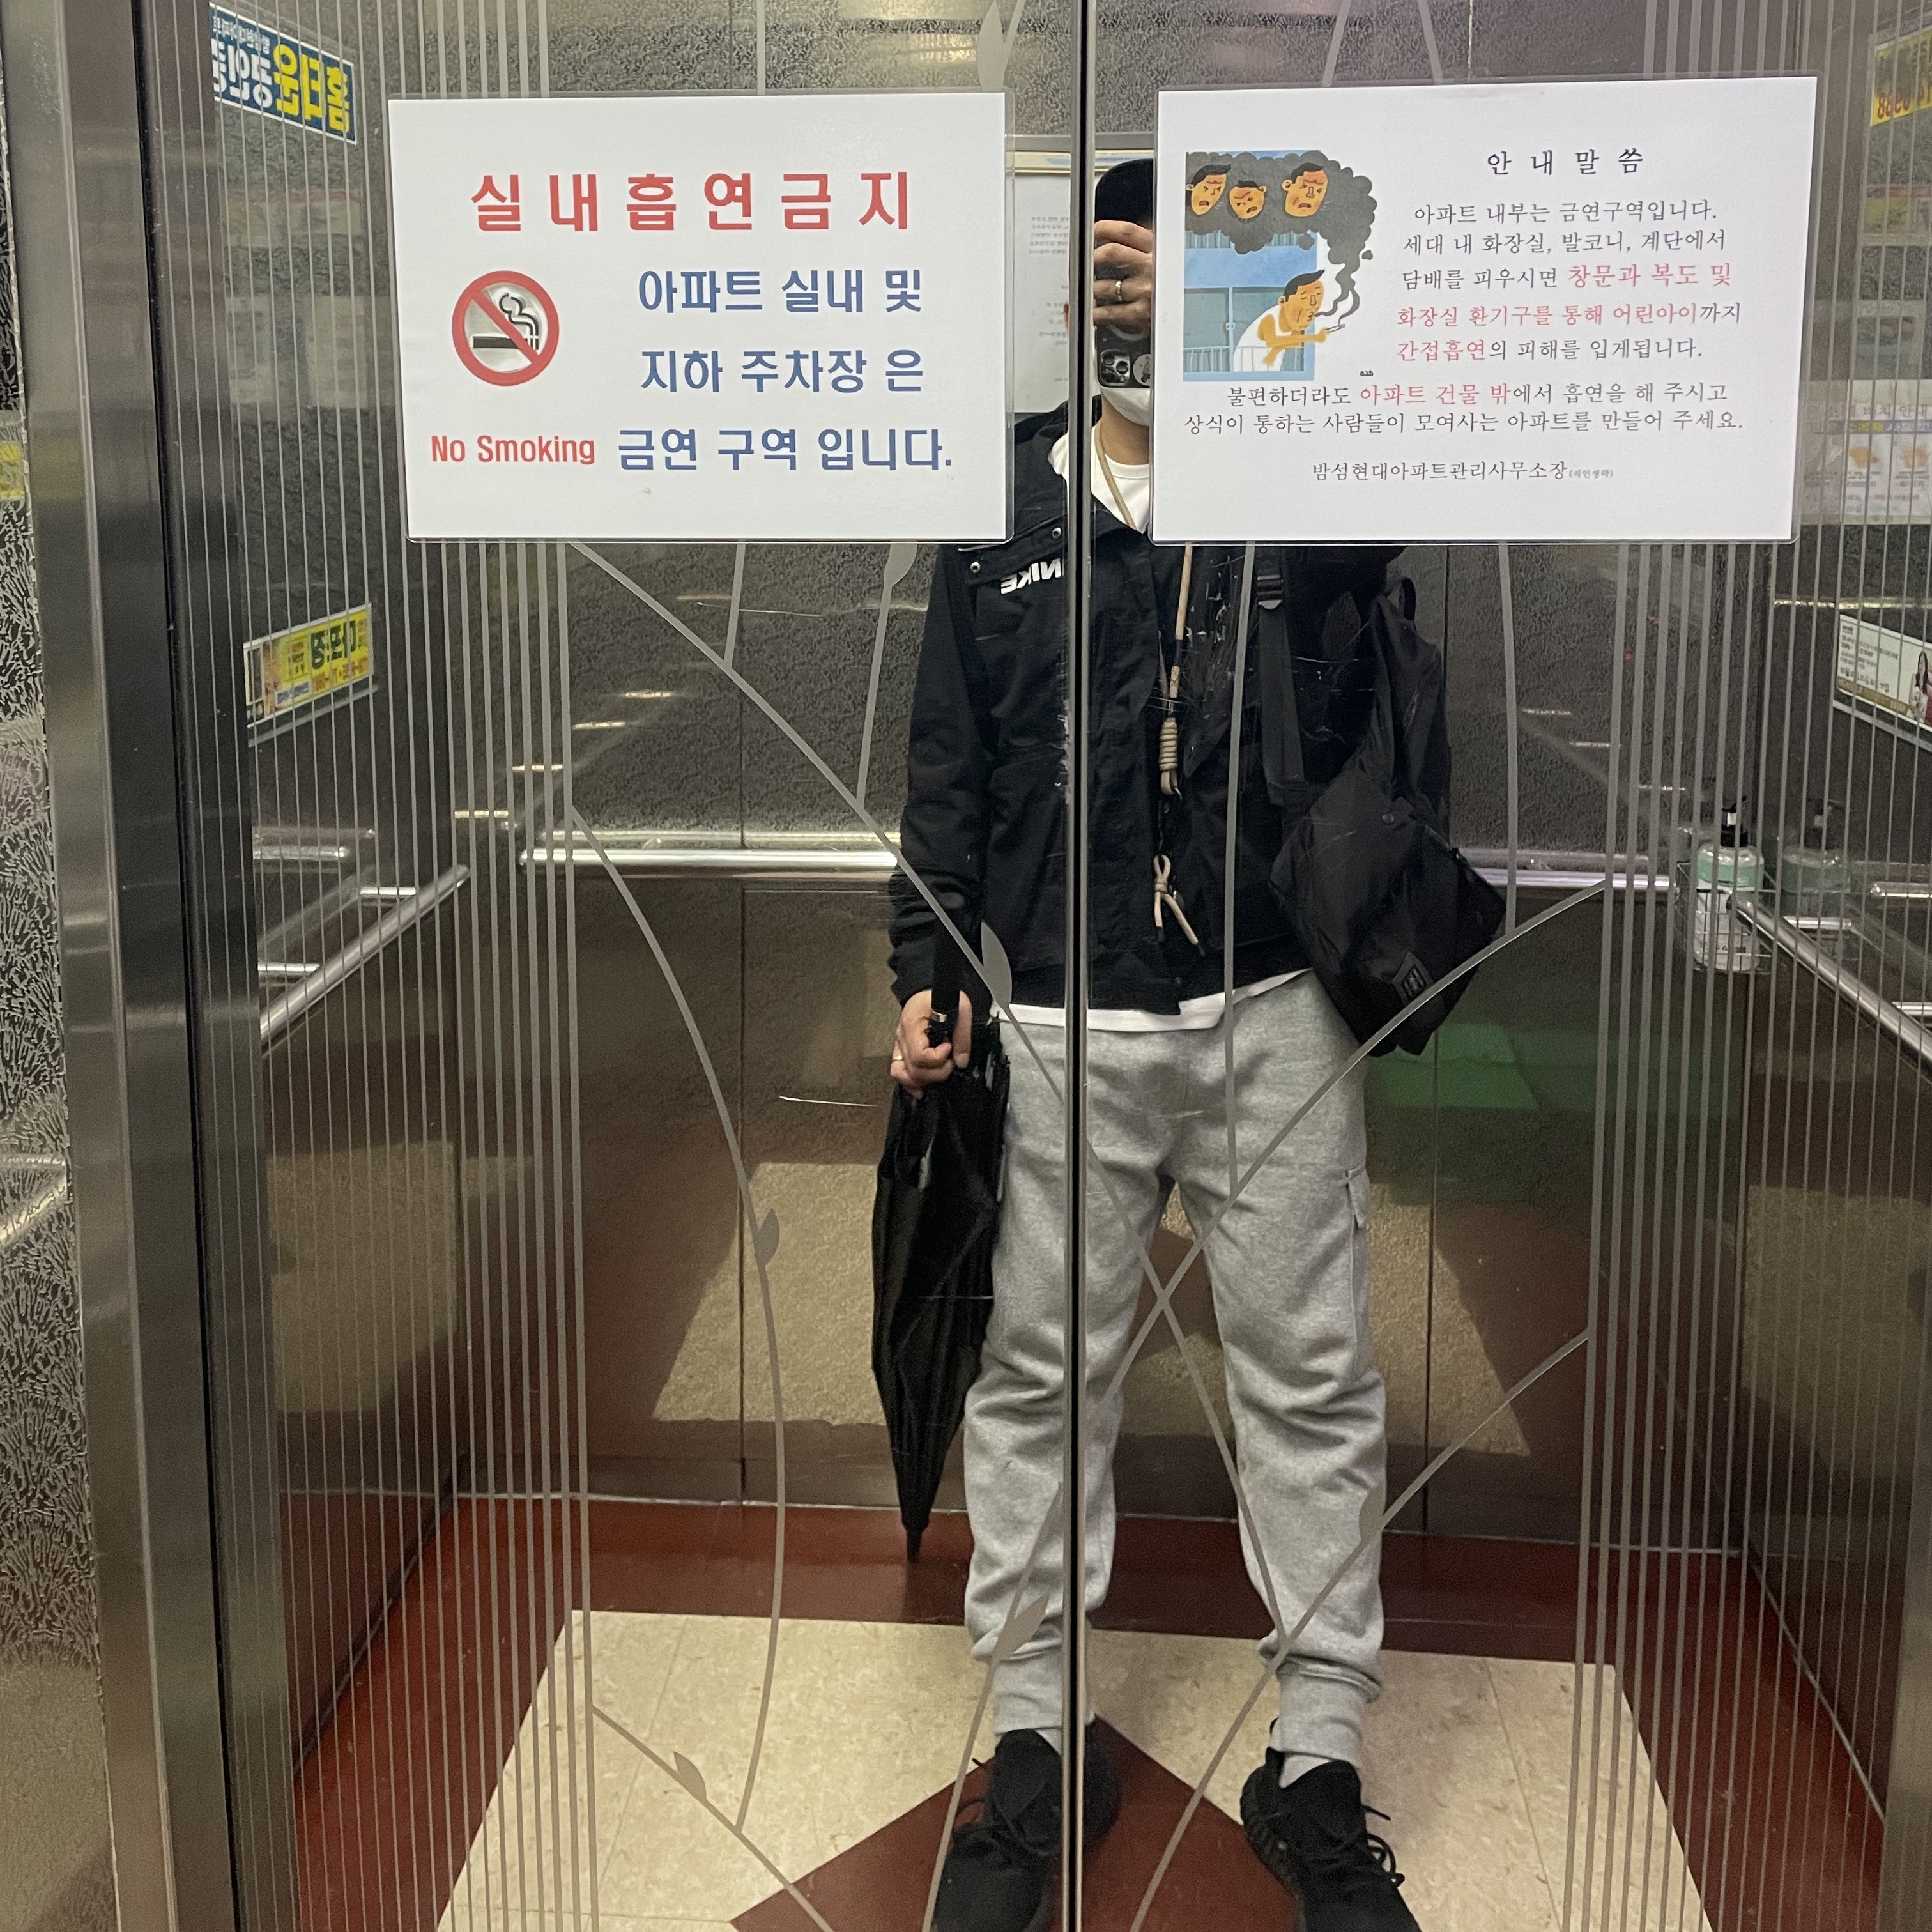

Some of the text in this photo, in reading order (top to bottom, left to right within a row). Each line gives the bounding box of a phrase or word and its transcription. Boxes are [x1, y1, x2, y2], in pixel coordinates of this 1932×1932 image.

[1414, 199, 1717, 226] 아파트 내부는 금연구역입니다.
[1403, 229, 1724, 256] 세대 내 화장실, 발코니, 계단에서
[1402, 262, 1730, 291] 담배를 피우시면 창문과 복도 및
[638, 268, 922, 314] 아파트 실내 및
[1397, 302, 1740, 328] 화장실 환기구를 통해 어린아이까지
[1397, 337, 1702, 362] 간접흡연의 피해를 입게됩니다.
[640, 349, 924, 394] 지하 주차장 은
[1227, 381, 1728, 407] 불편하더라도 아파트 건물 밖에서 흡연을 해 주시고
[1184, 410, 1743, 435] 상식이 통하는 사람들이 모여사는 아파트를 만들어 주세요.
[431, 434, 596, 466] No Smoking
[617, 428, 953, 471] 금연 구역 입니다.
